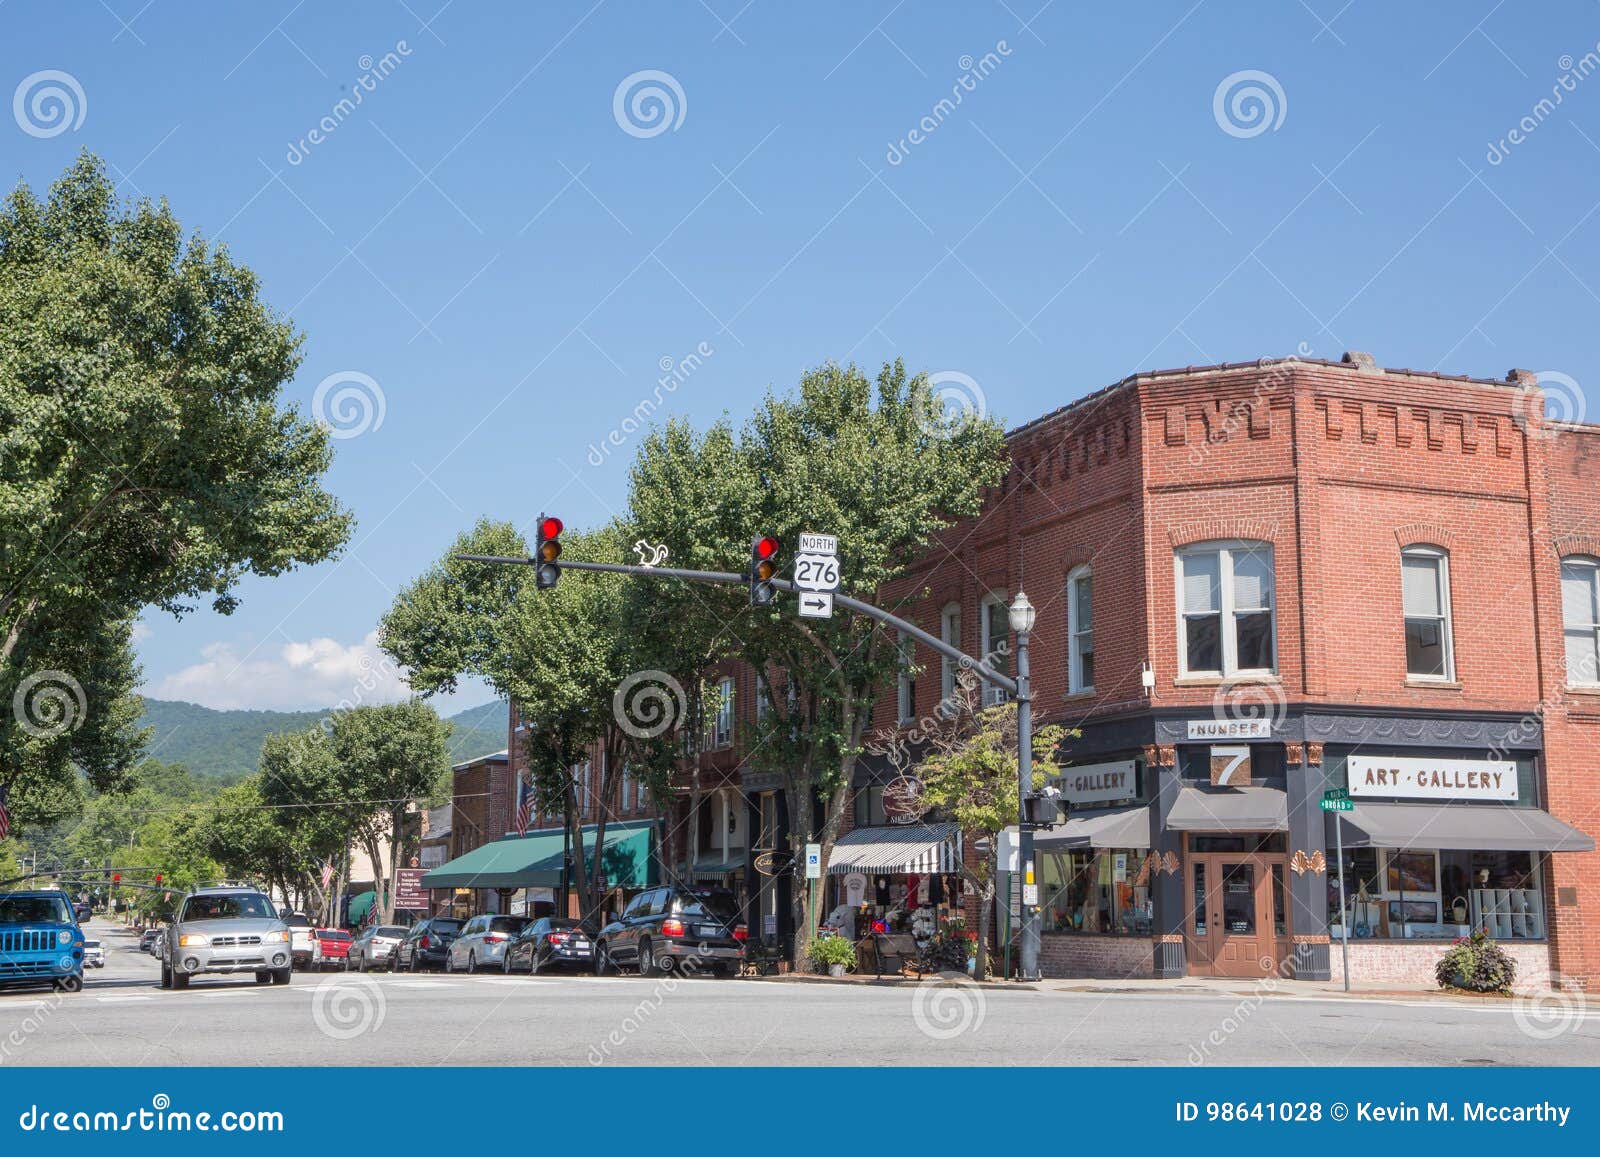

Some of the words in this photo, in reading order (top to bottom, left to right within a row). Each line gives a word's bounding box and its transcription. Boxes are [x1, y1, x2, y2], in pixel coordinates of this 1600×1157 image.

[802, 537, 834, 550] NORTH
[798, 560, 837, 583] 276
[1196, 723, 1260, 736] NUMBER
[1210, 745, 1250, 785] 7
[1075, 772, 1126, 791] GALLERY
[1365, 768, 1400, 786] ART
[1417, 770, 1503, 789] GALLERY
[1324, 800, 1346, 810] BROAD
